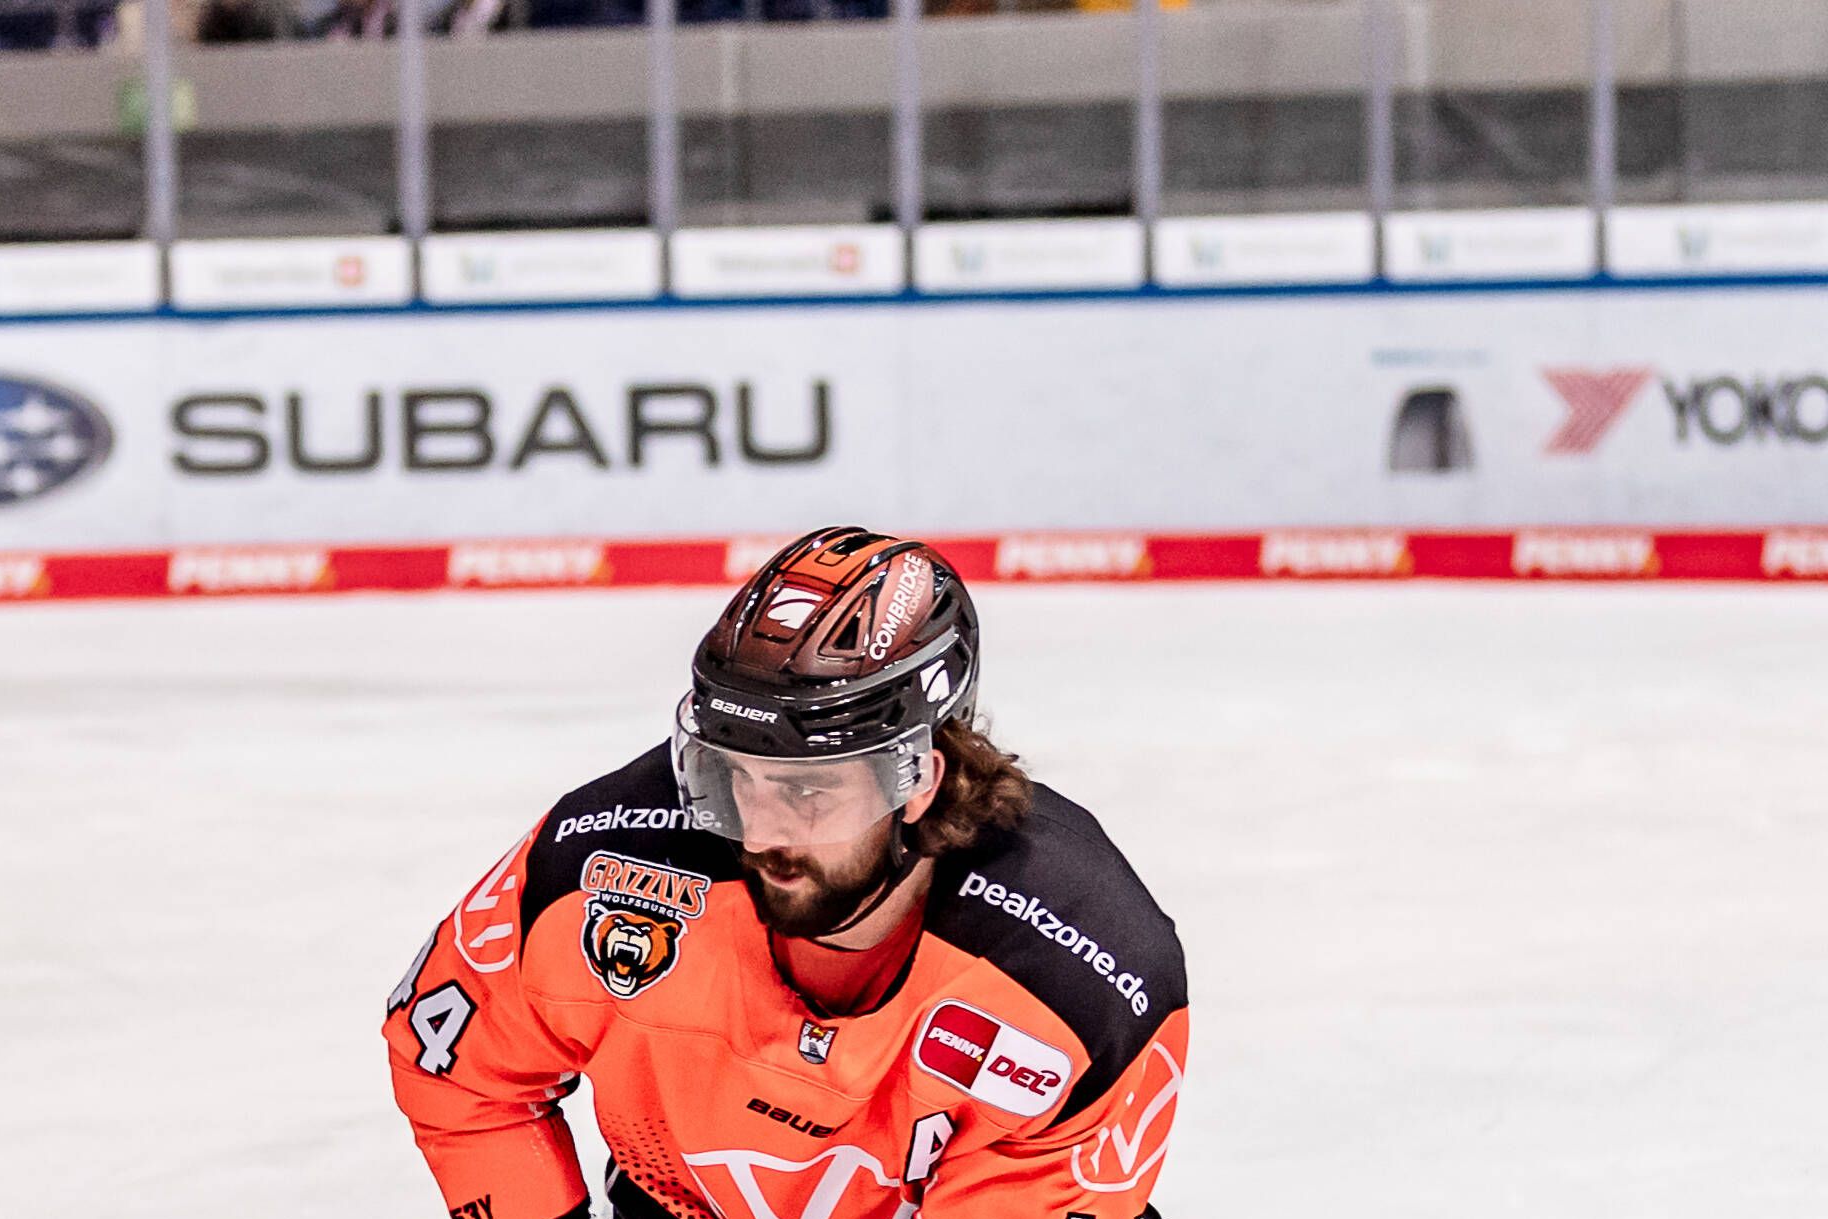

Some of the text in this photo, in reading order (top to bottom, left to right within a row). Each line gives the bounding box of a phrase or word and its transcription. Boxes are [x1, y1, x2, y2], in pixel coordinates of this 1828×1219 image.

[170, 378, 833, 476] SUBARU
[869, 551, 923, 661] COMBRIDGE
[709, 697, 778, 724] BAUER
[583, 855, 708, 915] GRIZZLYS
[601, 891, 676, 918] WOLFSBURG
[958, 871, 1150, 1017] peakzone.de
[927, 1026, 1061, 1097] PENNY DEL
[746, 1097, 841, 1139] BAUE
